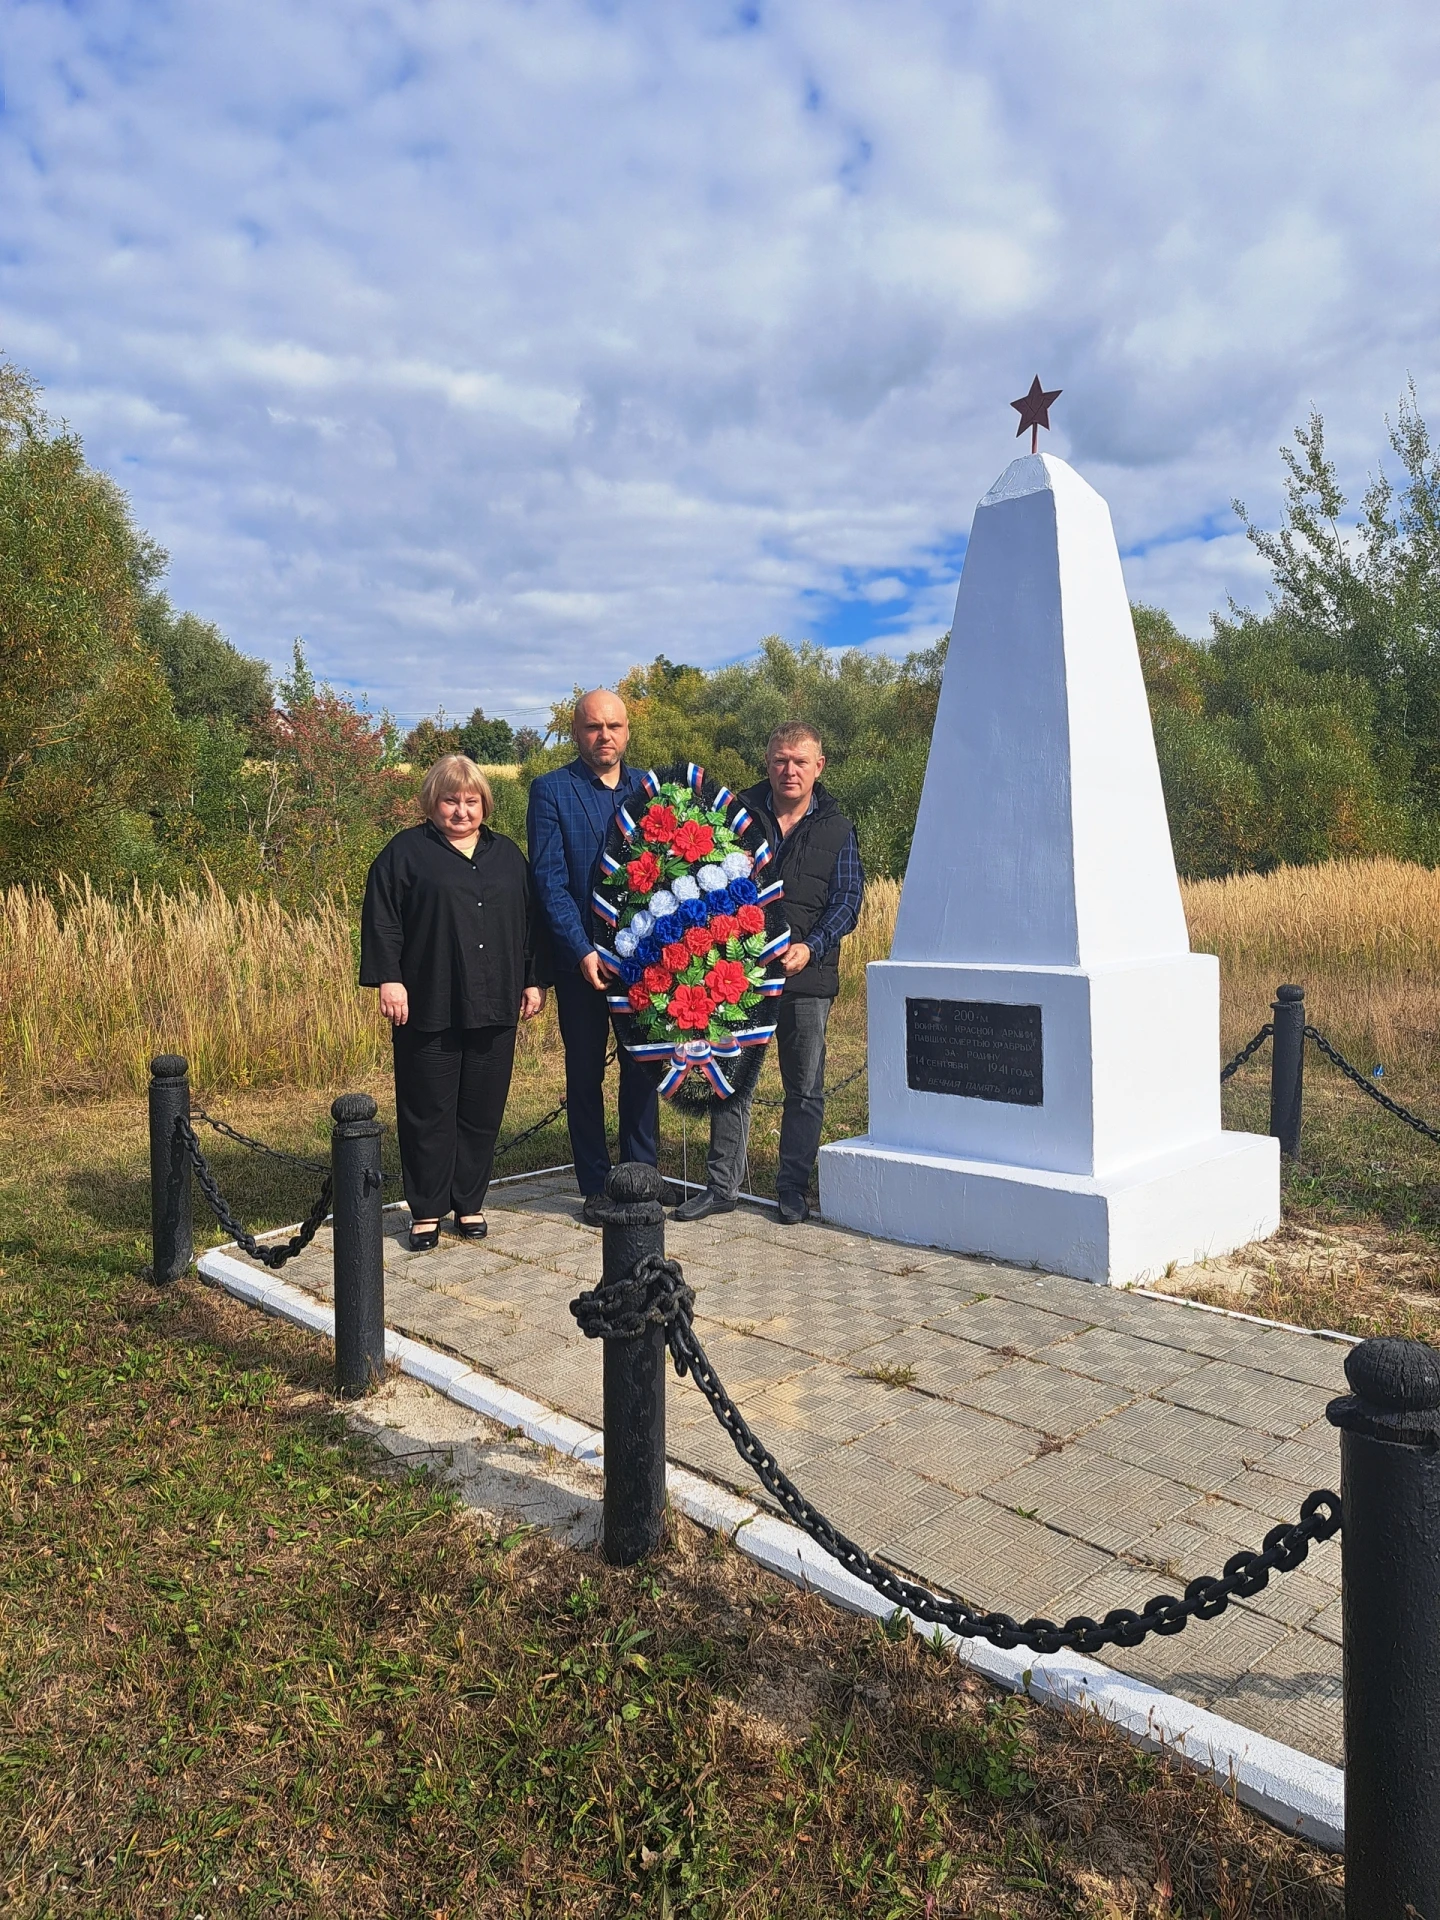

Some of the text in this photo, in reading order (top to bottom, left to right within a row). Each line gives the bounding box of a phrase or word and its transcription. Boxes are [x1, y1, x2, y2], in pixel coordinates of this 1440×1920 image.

[914, 1022, 1034, 1039] ВОИНАМ КРАСНОЙ АРМИИ
[914, 1033, 1034, 1052] ПАВШИХ СМЕРТЬЮ ХРАБРЫХ
[967, 1050, 1001, 1061] РОДИНУ
[915, 1055, 1034, 1078] 14 СЕНТЯБРЯ 1941 ГОДА
[928, 1077, 1022, 1096] ВЕЧНАЯ ПАМЯТЬ ИМ
